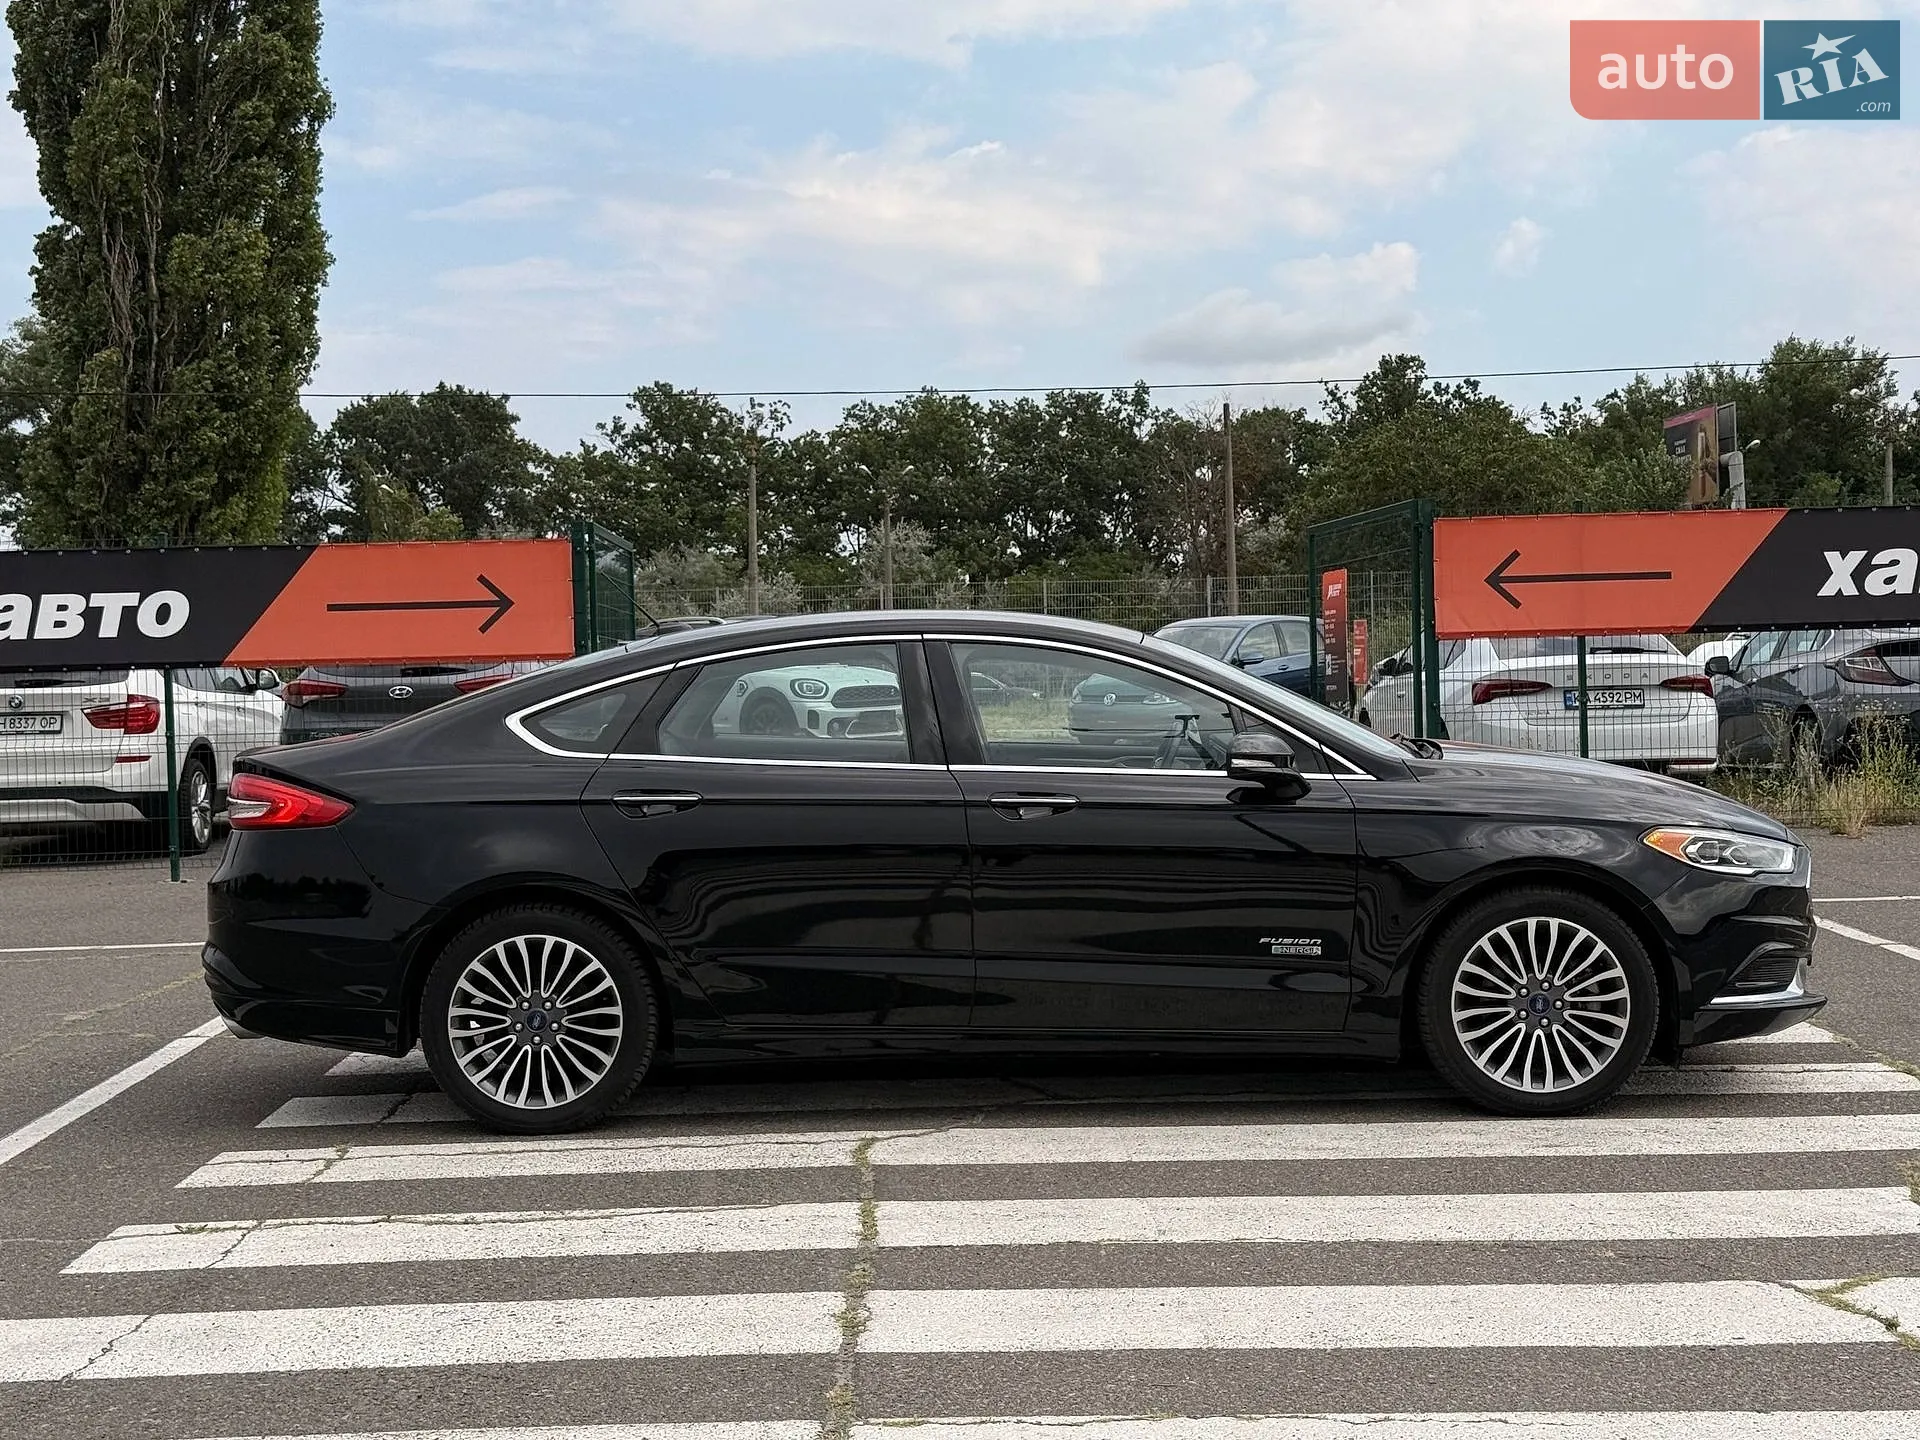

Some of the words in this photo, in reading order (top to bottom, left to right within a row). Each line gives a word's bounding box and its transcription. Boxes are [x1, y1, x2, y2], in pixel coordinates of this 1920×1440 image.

[1816, 548, 1920, 597] ха
[1593, 691, 1623, 704] 4592
[8, 717, 37, 730] 8337
